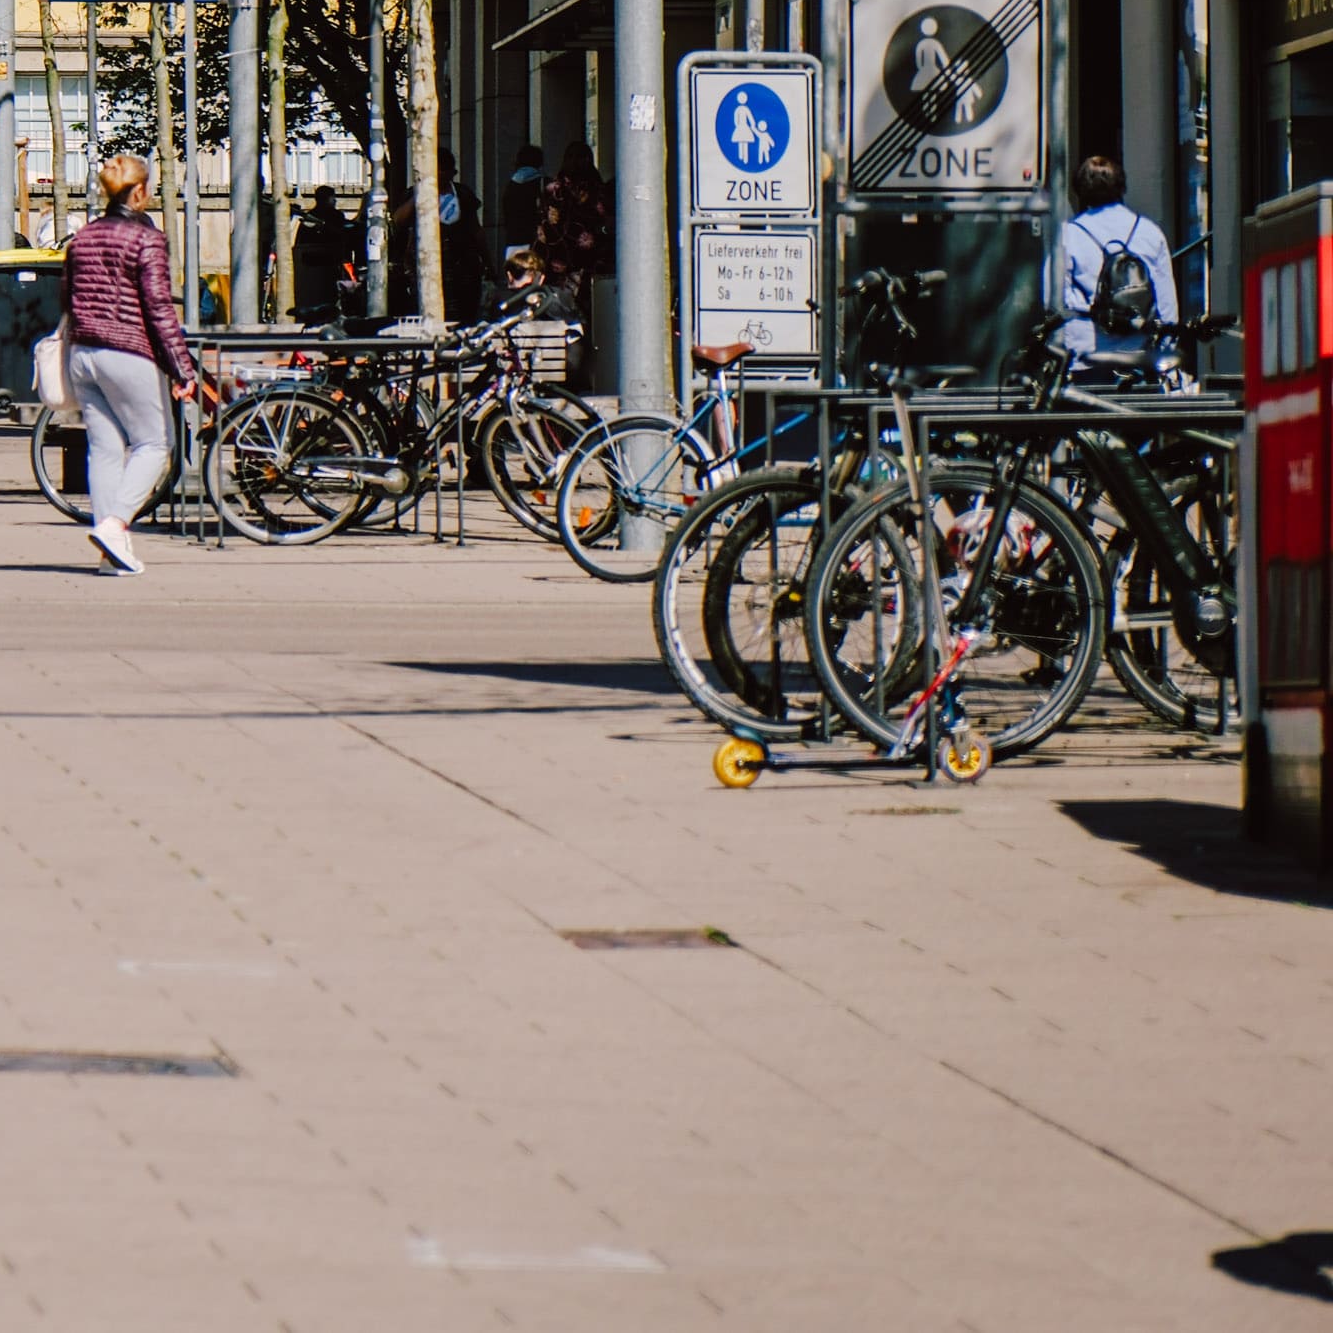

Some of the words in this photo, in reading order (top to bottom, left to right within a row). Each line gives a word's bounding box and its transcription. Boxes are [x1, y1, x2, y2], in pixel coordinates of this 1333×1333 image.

[899, 147, 993, 178] ZONE
[726, 180, 782, 201] ZONE
[708, 244, 779, 258] Lieferverkehr
[785, 244, 803, 259] frei
[718, 286, 731, 300] Sa
